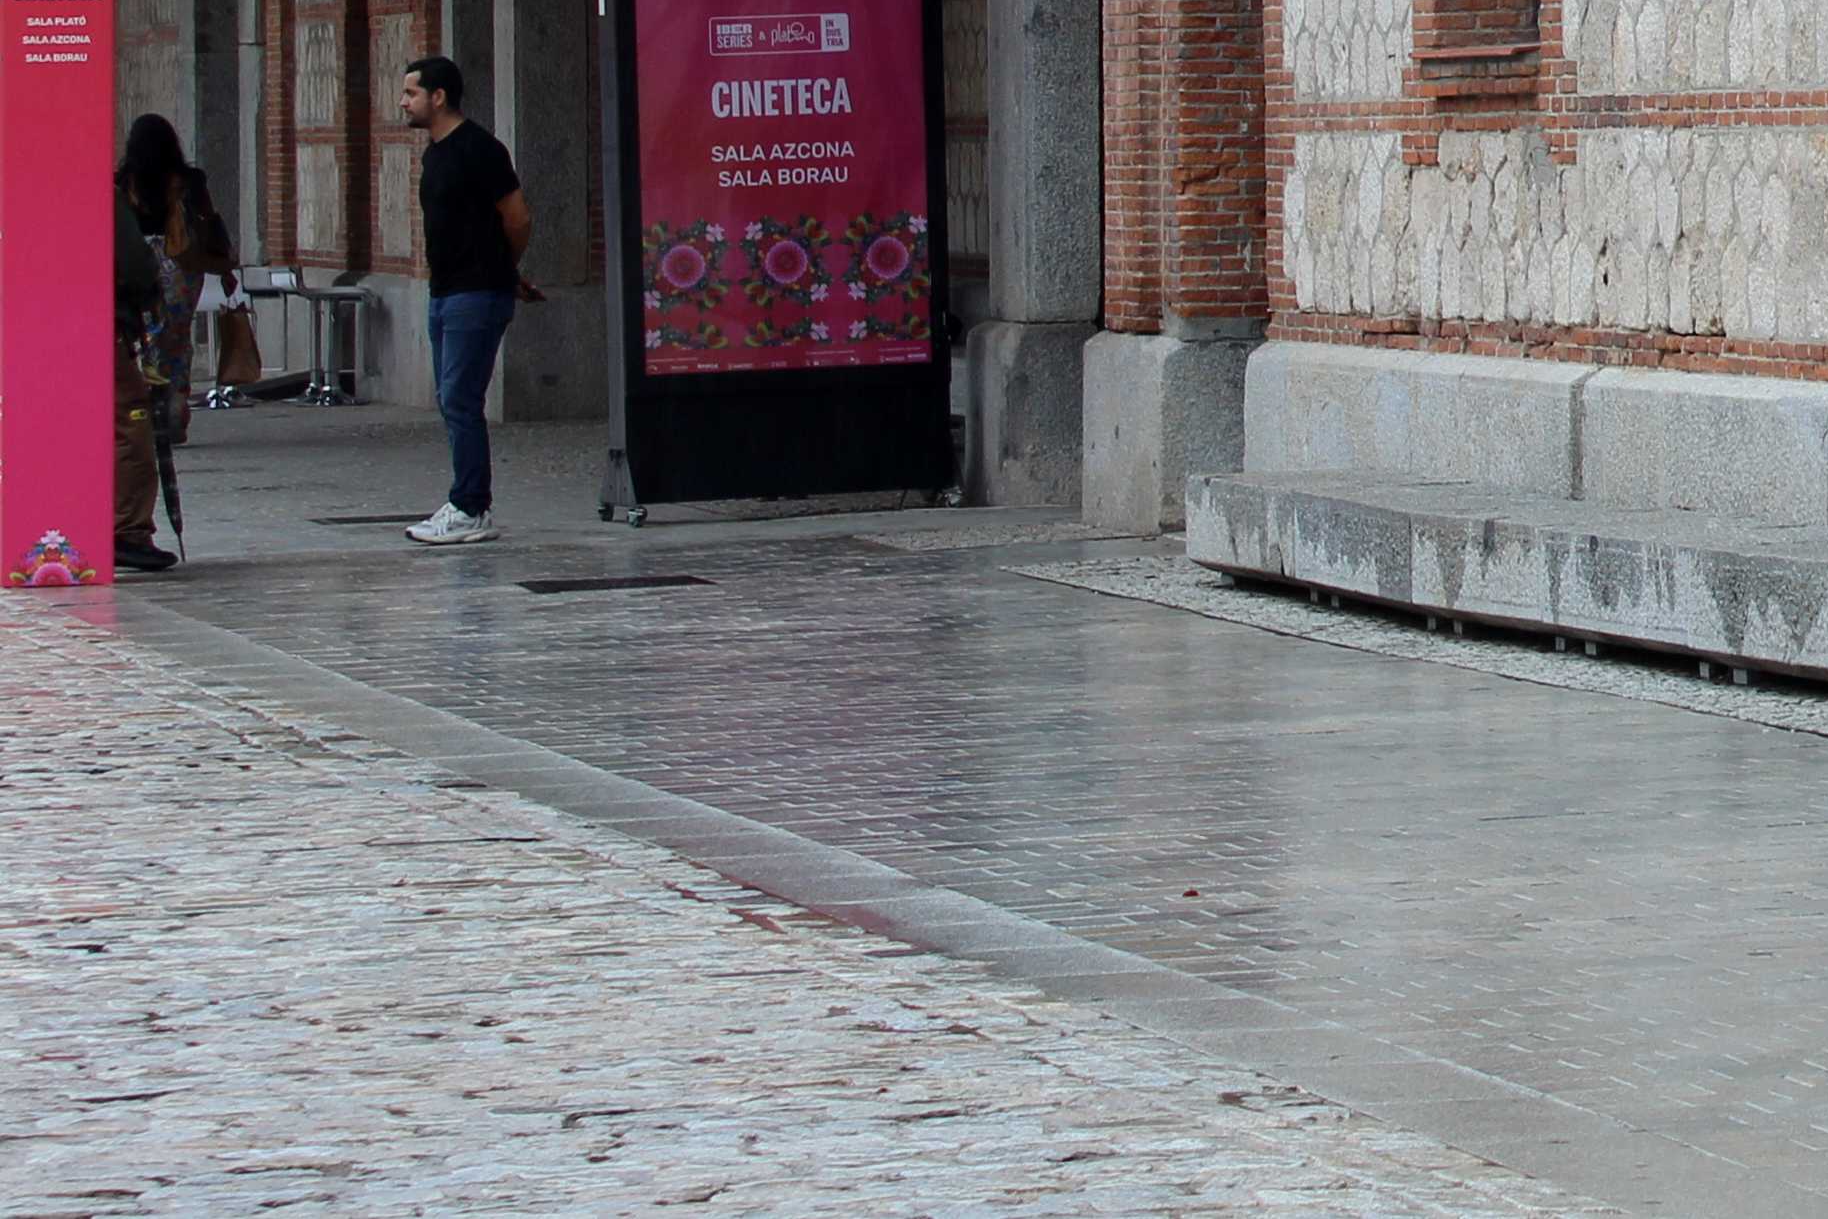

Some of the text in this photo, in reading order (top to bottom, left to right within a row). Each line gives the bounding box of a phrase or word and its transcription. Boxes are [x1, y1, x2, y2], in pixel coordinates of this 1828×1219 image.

[26, 15, 87, 26] SALA PLATÓ
[22, 34, 91, 45] SALA AZCONA
[717, 35, 753, 49] SERIES
[25, 52, 88, 62] SALA BORAU
[711, 77, 852, 118] CINETECA
[711, 141, 855, 162] SALA AZCONA
[718, 166, 848, 187] SALA BORAU
